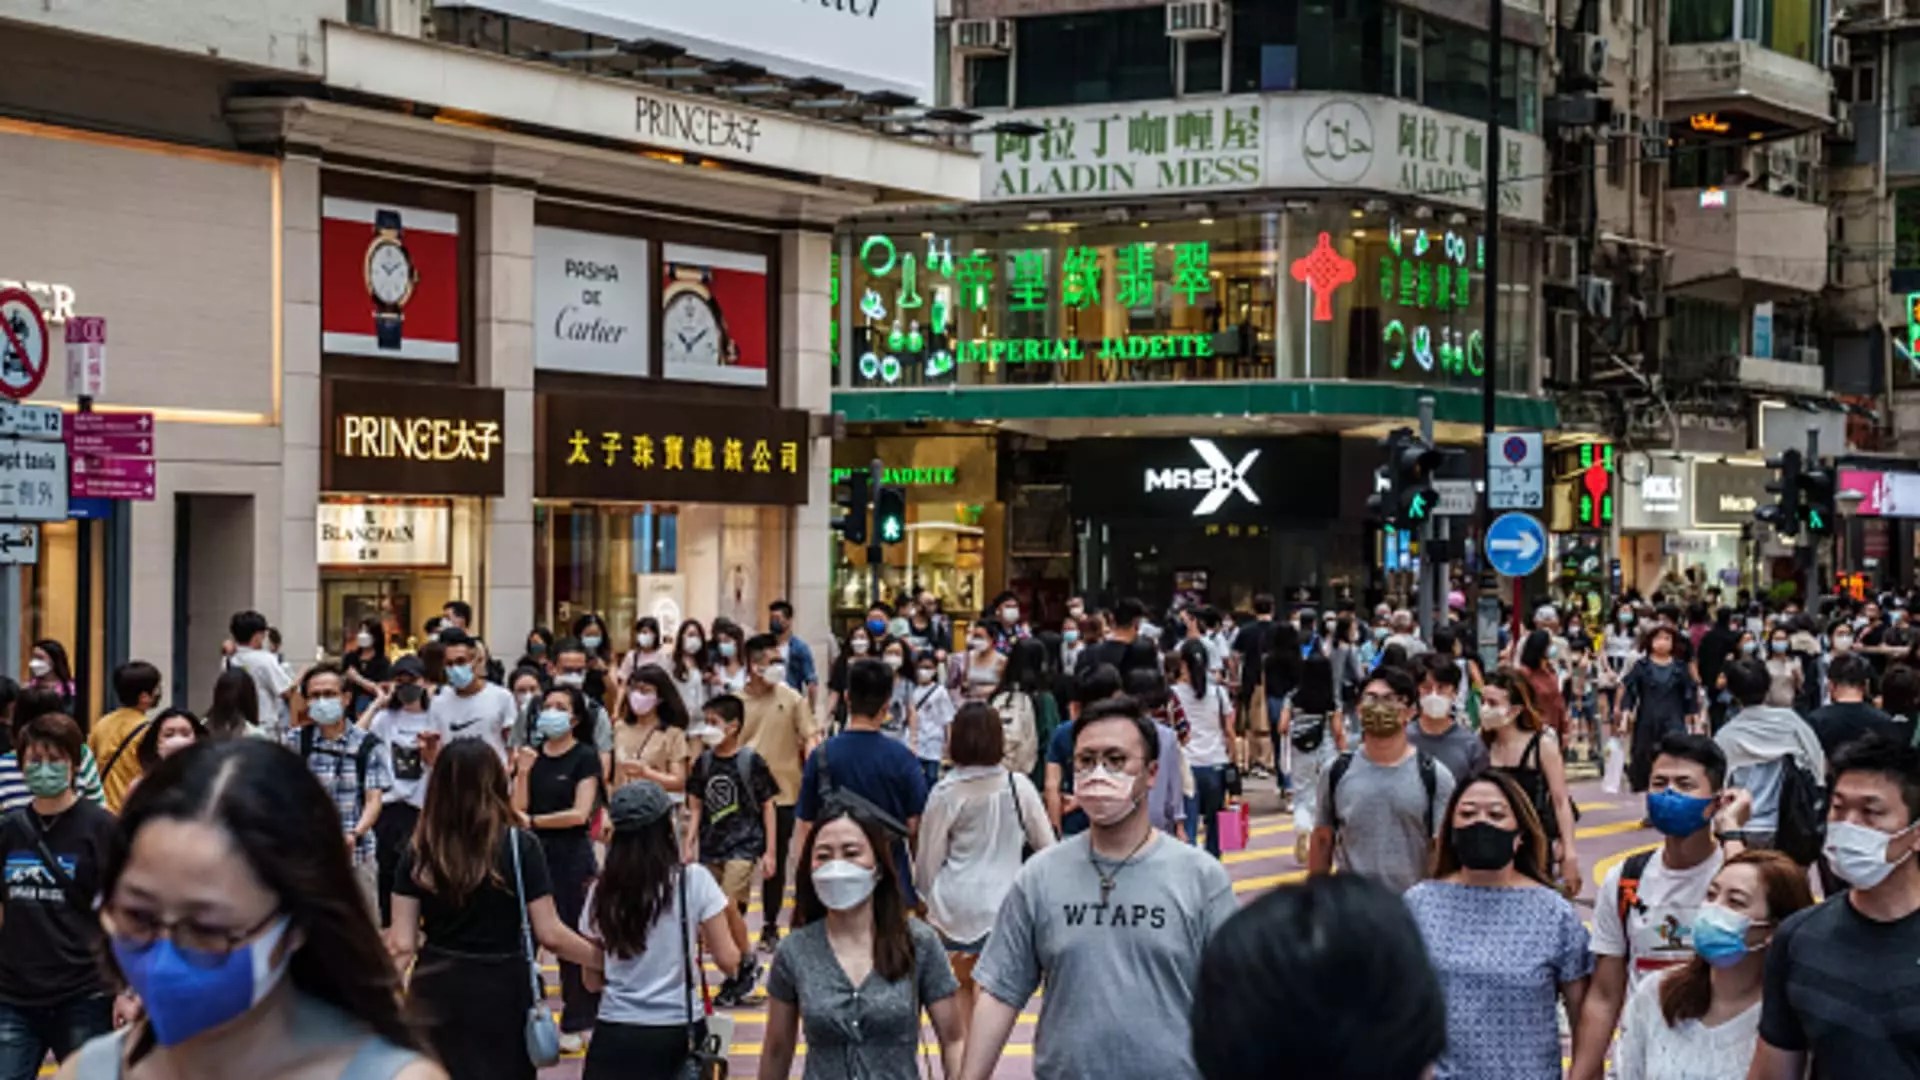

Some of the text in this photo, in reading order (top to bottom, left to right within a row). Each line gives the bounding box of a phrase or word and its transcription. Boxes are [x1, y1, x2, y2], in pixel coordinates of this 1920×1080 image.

[992, 154, 1260, 196] ALADIN MESS
[565, 259, 619, 282] PASHA
[582, 290, 602, 305] DE
[555, 304, 627, 344] Cartier
[956, 334, 1214, 362] IMPERIAL JADEITE
[44, 412, 58, 431] 12
[25, 451, 56, 470] taxis
[1063, 903, 1165, 929] WTAPS
